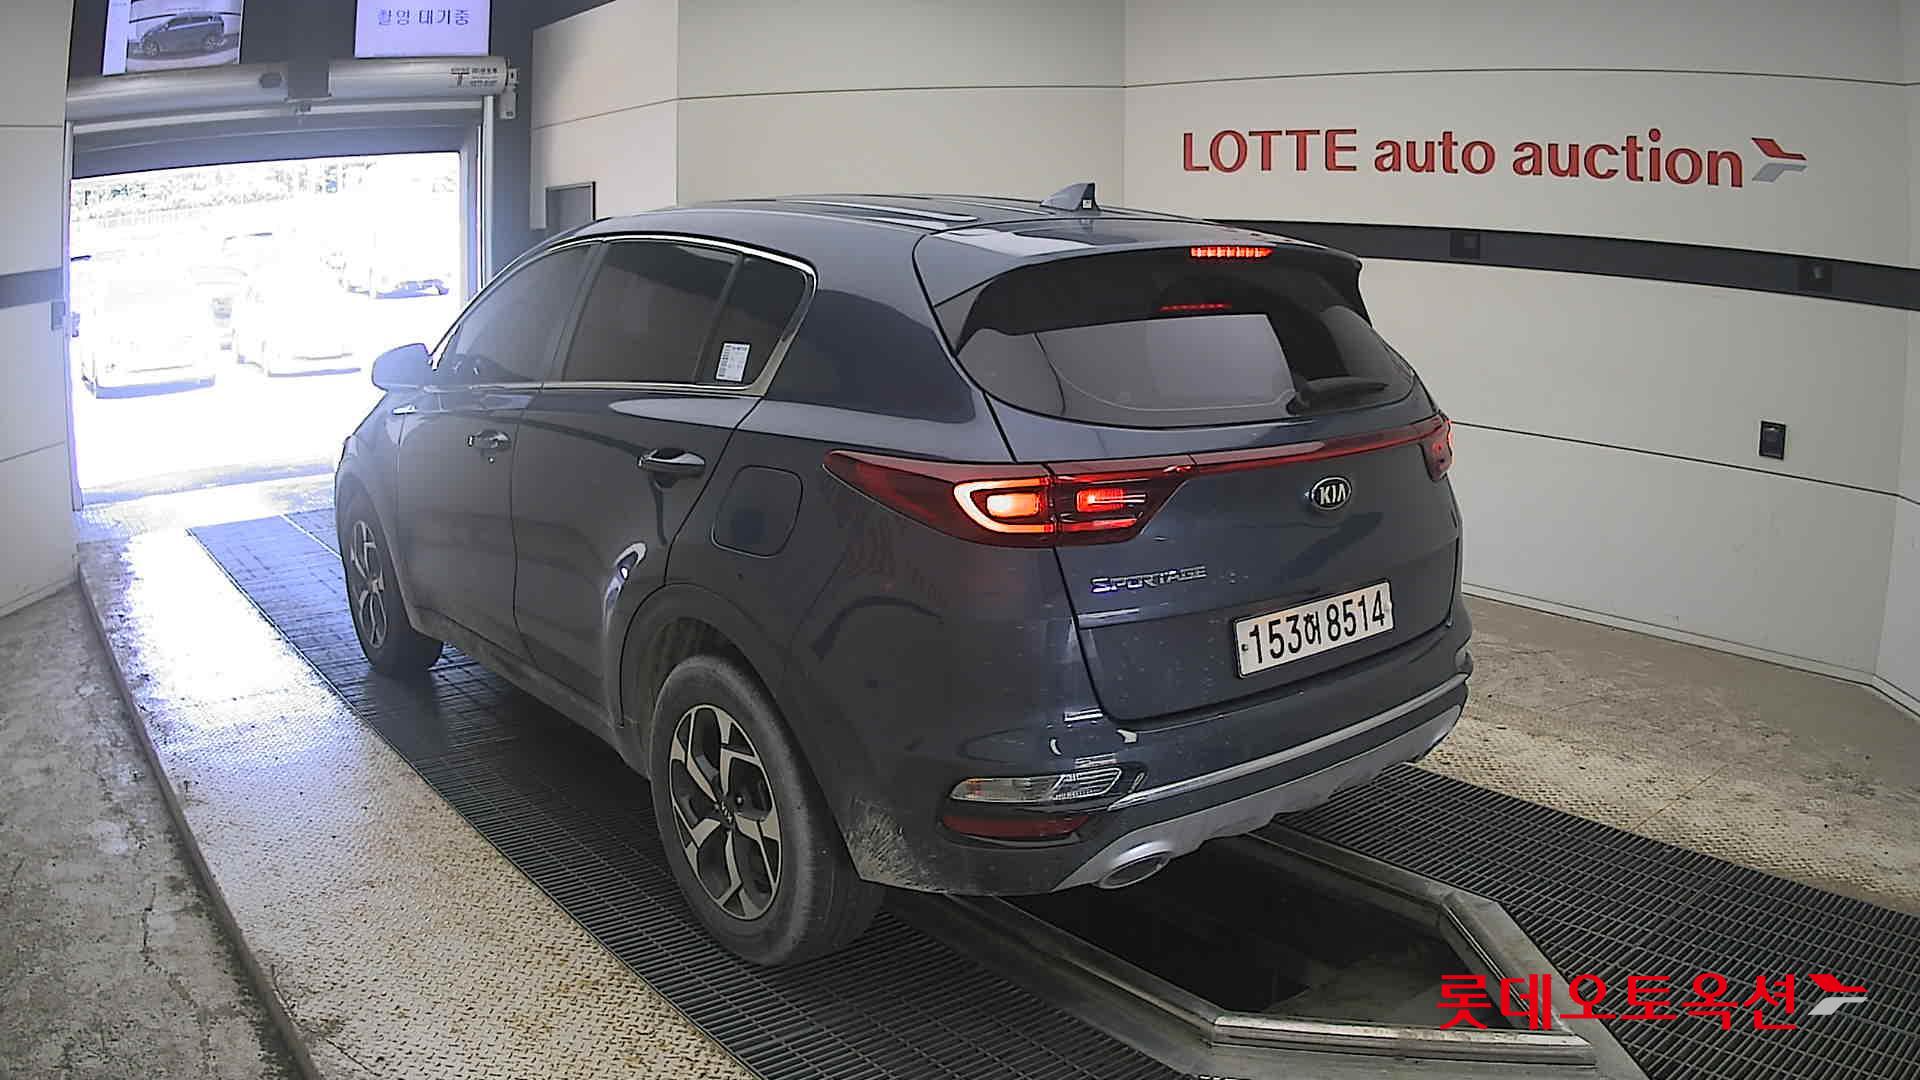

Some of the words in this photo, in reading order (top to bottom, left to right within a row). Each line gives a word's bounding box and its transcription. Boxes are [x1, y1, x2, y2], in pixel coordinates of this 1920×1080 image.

[377, 8, 410, 26] 촬영
[418, 8, 470, 26] 대기중
[1183, 128, 1357, 173] LOTTE
[1374, 131, 1496, 174] auto
[1512, 128, 1743, 188] auction
[1319, 483, 1346, 505] KIA
[1091, 565, 1207, 593] SPORTAGE
[1326, 589, 1386, 642] 8514
